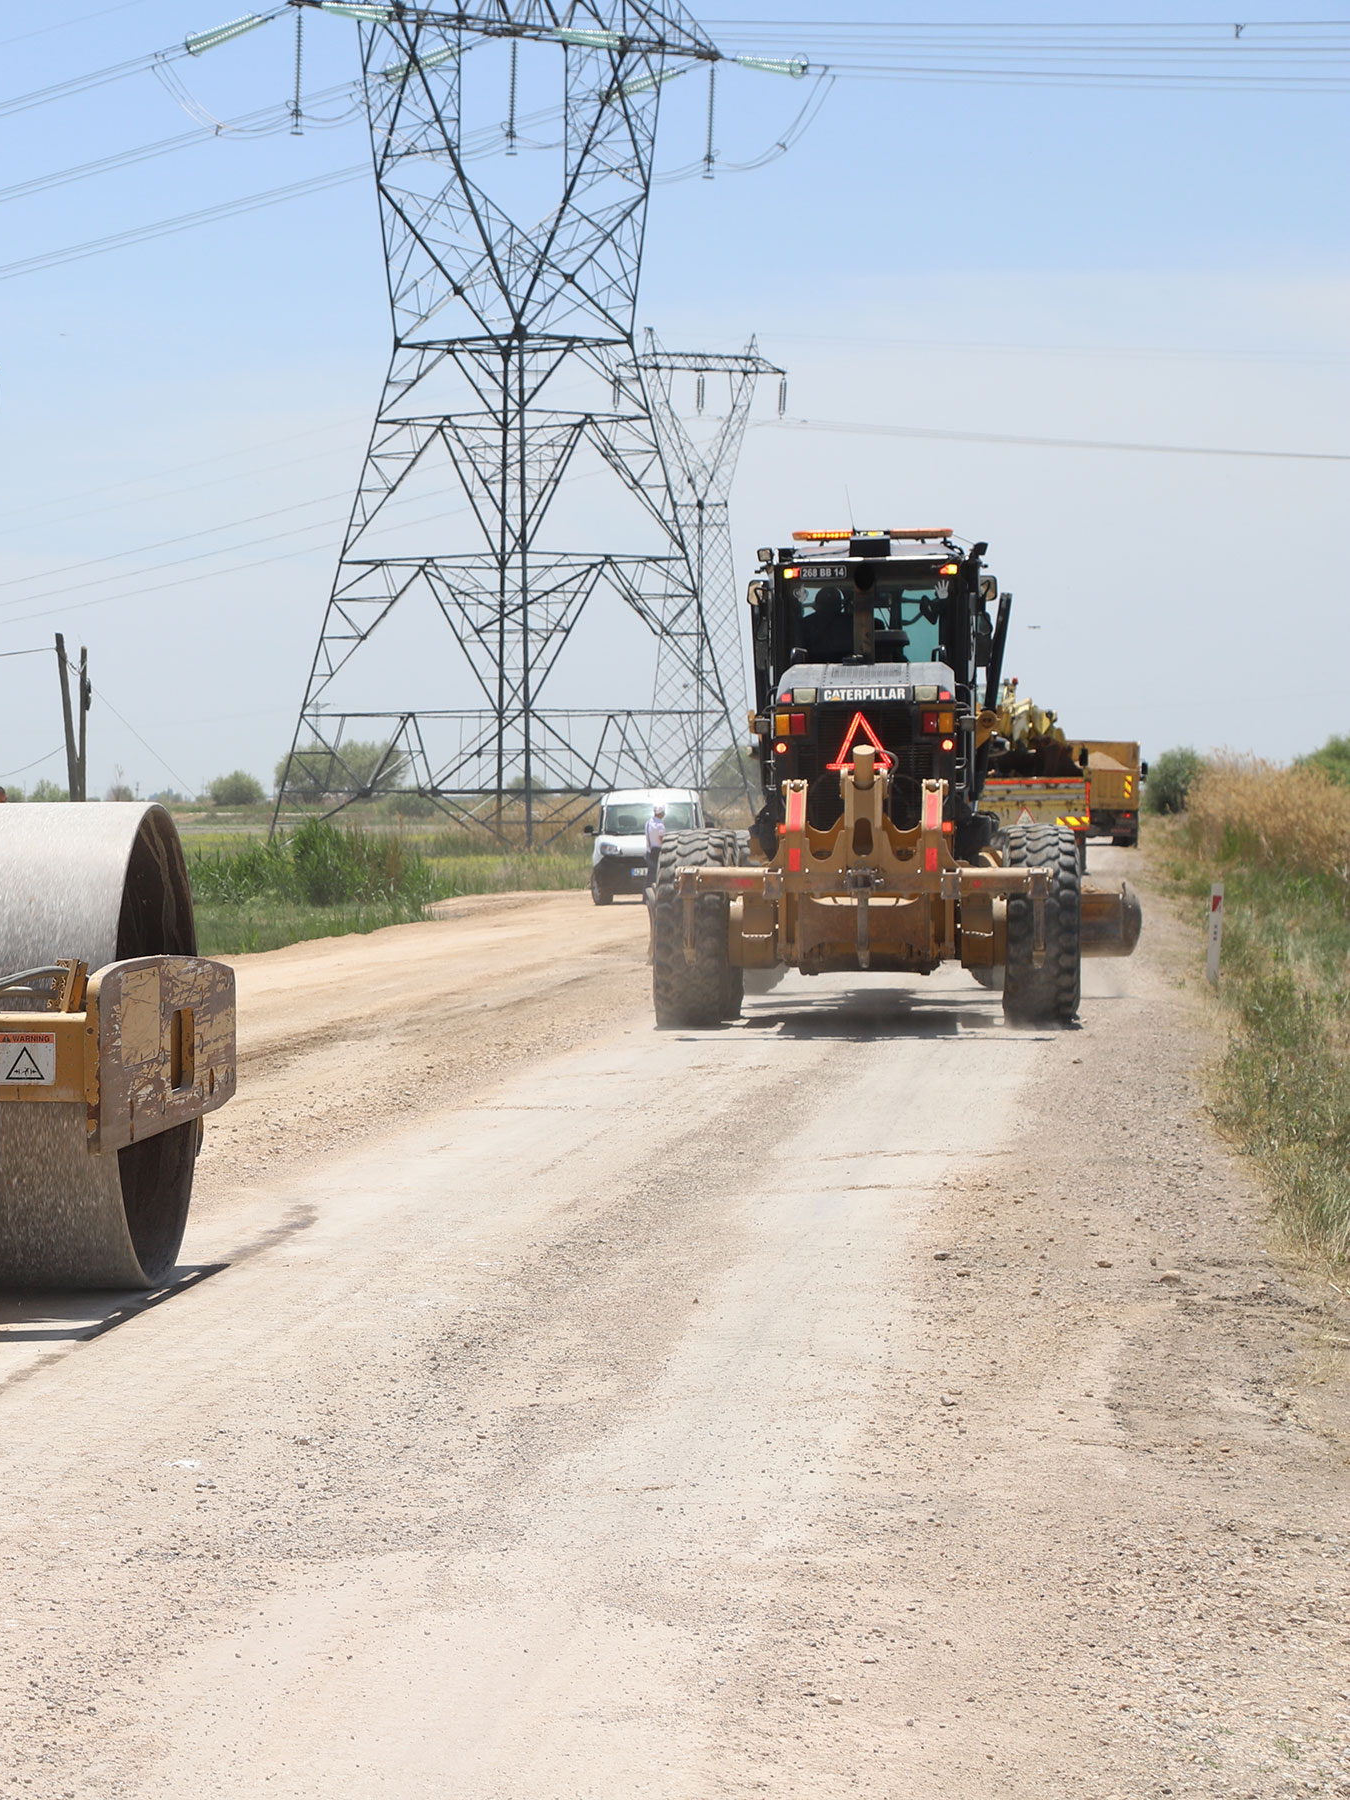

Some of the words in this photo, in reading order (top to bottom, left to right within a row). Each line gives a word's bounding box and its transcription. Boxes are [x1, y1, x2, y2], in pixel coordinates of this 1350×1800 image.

[802, 568, 818, 577] 268
[819, 568, 832, 577] BB
[834, 567, 844, 577] 14
[823, 688, 906, 701] CATERPILLAR
